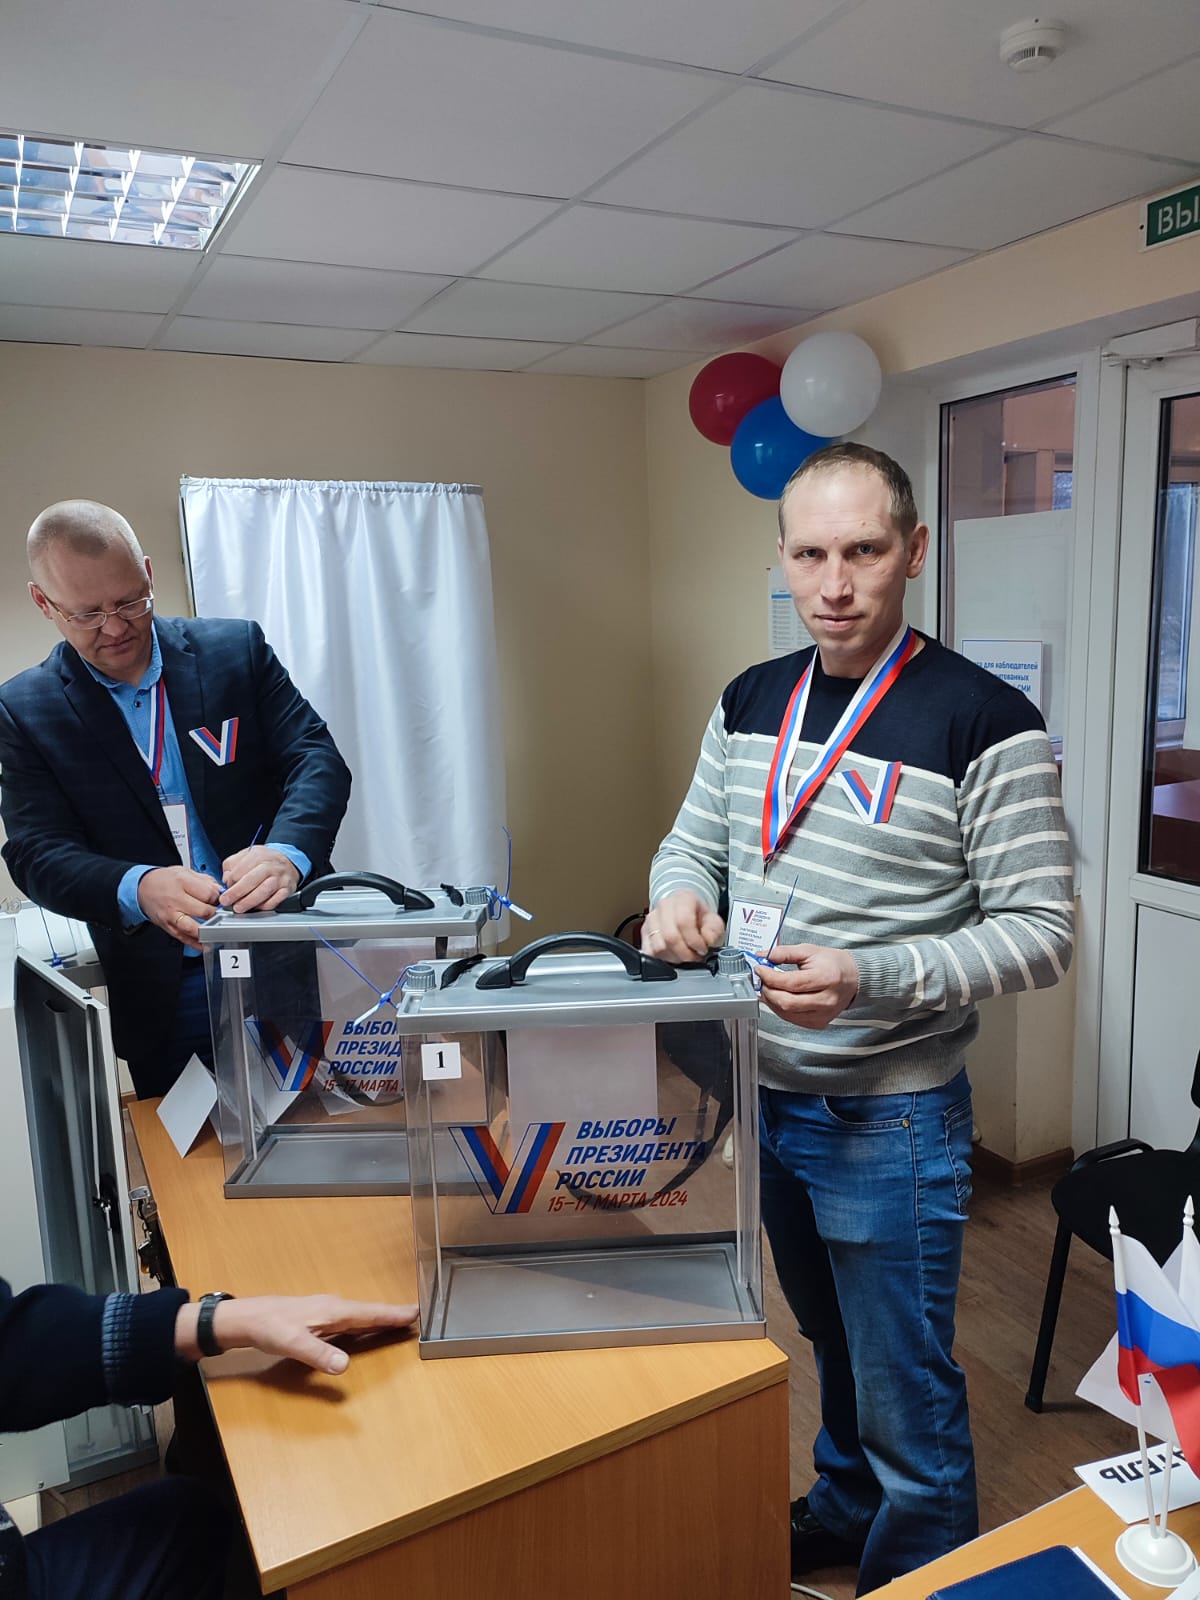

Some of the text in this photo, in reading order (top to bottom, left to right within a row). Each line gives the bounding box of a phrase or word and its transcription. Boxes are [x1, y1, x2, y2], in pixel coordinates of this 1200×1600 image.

[1158, 195, 1200, 235] ВЫ
[230, 955, 240, 969] 2
[335, 1041, 402, 1057] ПРЕЗИД
[328, 1061, 398, 1075] РОССИИ
[436, 1050, 446, 1069] 1
[358, 1079, 399, 1092] МАРТА
[576, 1117, 677, 1140] ВЫБОРЫ
[565, 1142, 708, 1165] ПРЕЗИДЕНТА
[555, 1169, 647, 1190] РОССИИ
[592, 1192, 647, 1210] МАРТА
[648, 1190, 688, 1208] 2024
